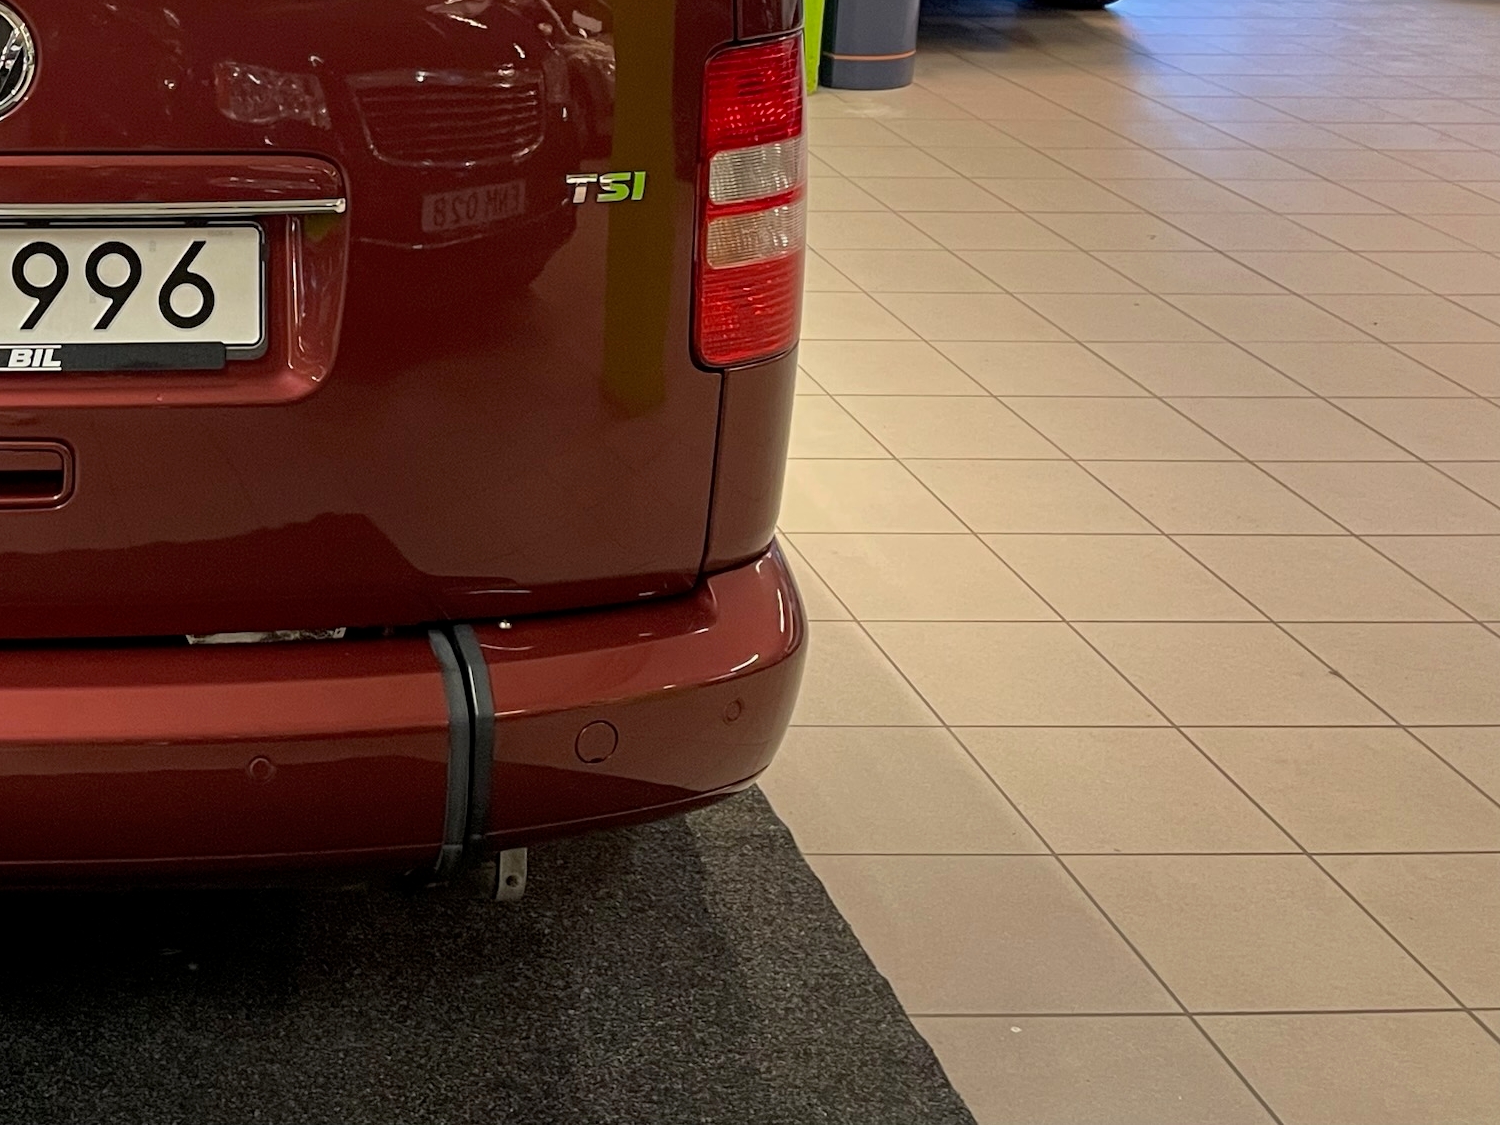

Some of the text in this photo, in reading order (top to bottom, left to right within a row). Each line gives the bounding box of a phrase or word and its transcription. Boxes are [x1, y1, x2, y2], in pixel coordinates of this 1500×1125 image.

[566, 171, 647, 204] TSI
[11, 240, 216, 331] 996
[8, 348, 62, 368] BIL
